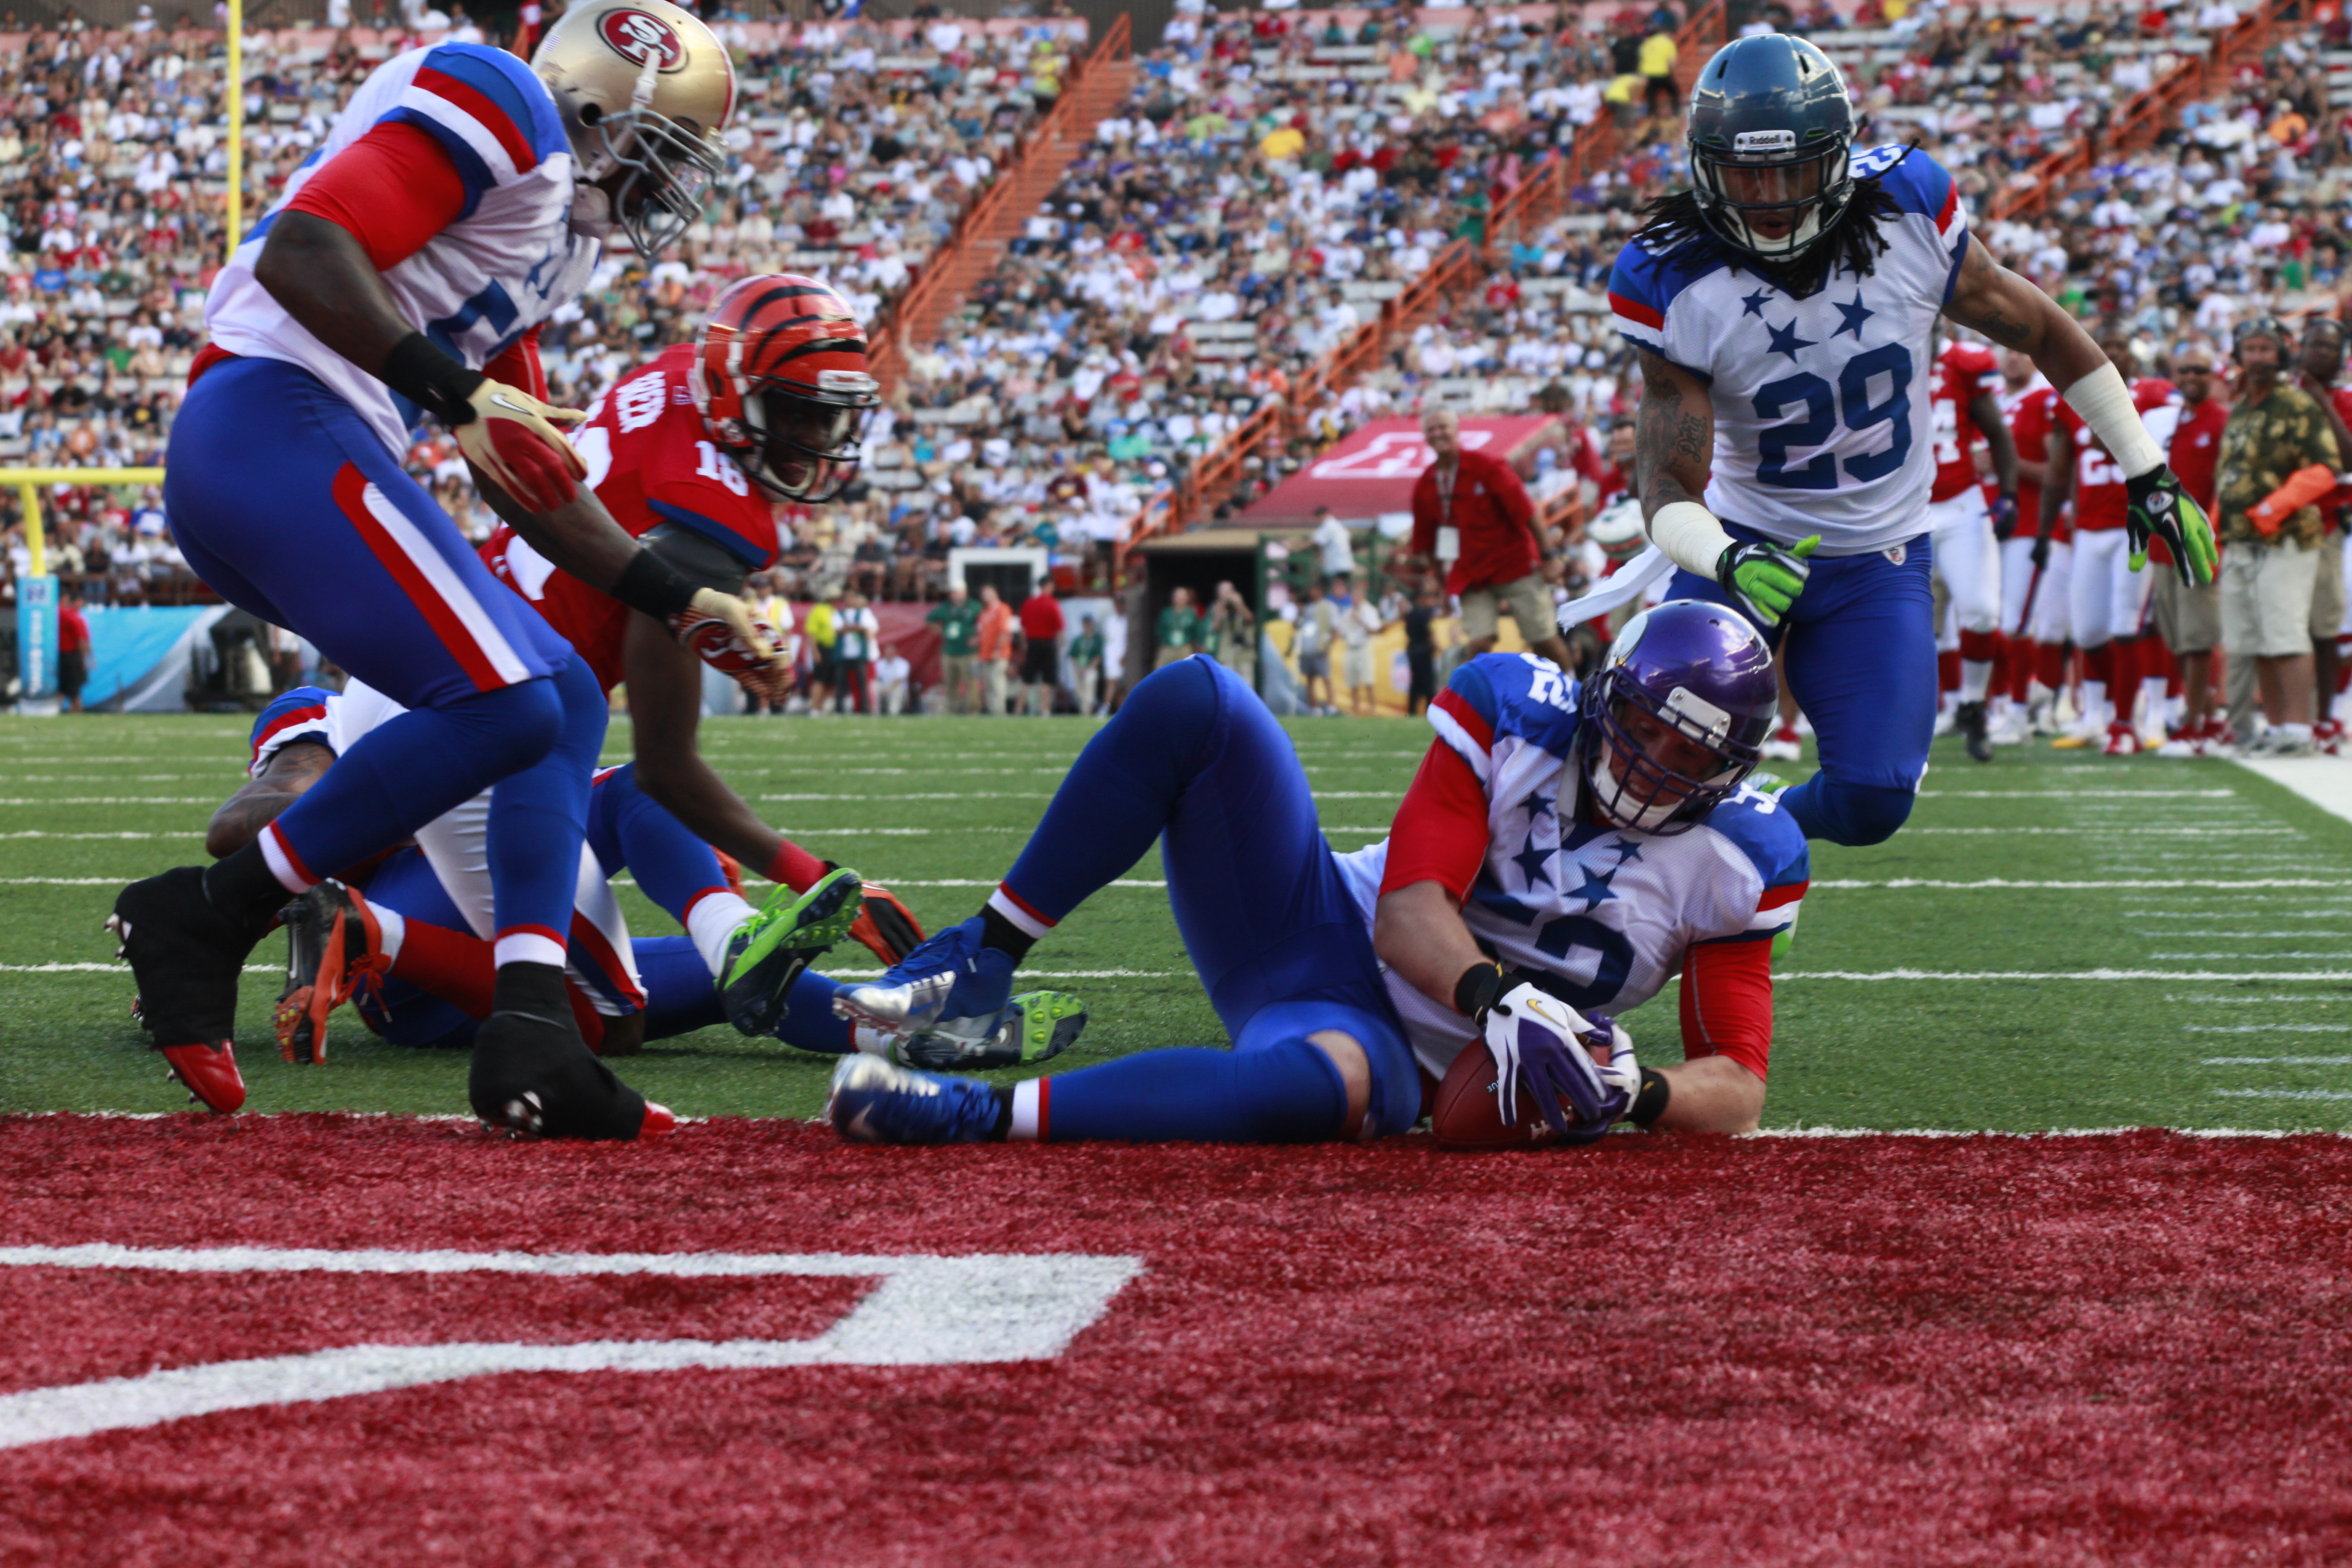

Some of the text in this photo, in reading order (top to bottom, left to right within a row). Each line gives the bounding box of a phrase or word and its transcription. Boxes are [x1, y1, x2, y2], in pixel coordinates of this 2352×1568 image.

[1749, 134, 1780, 144] Riddell
[1847, 143, 1906, 178] 2
[1751, 342, 1912, 489] 29
